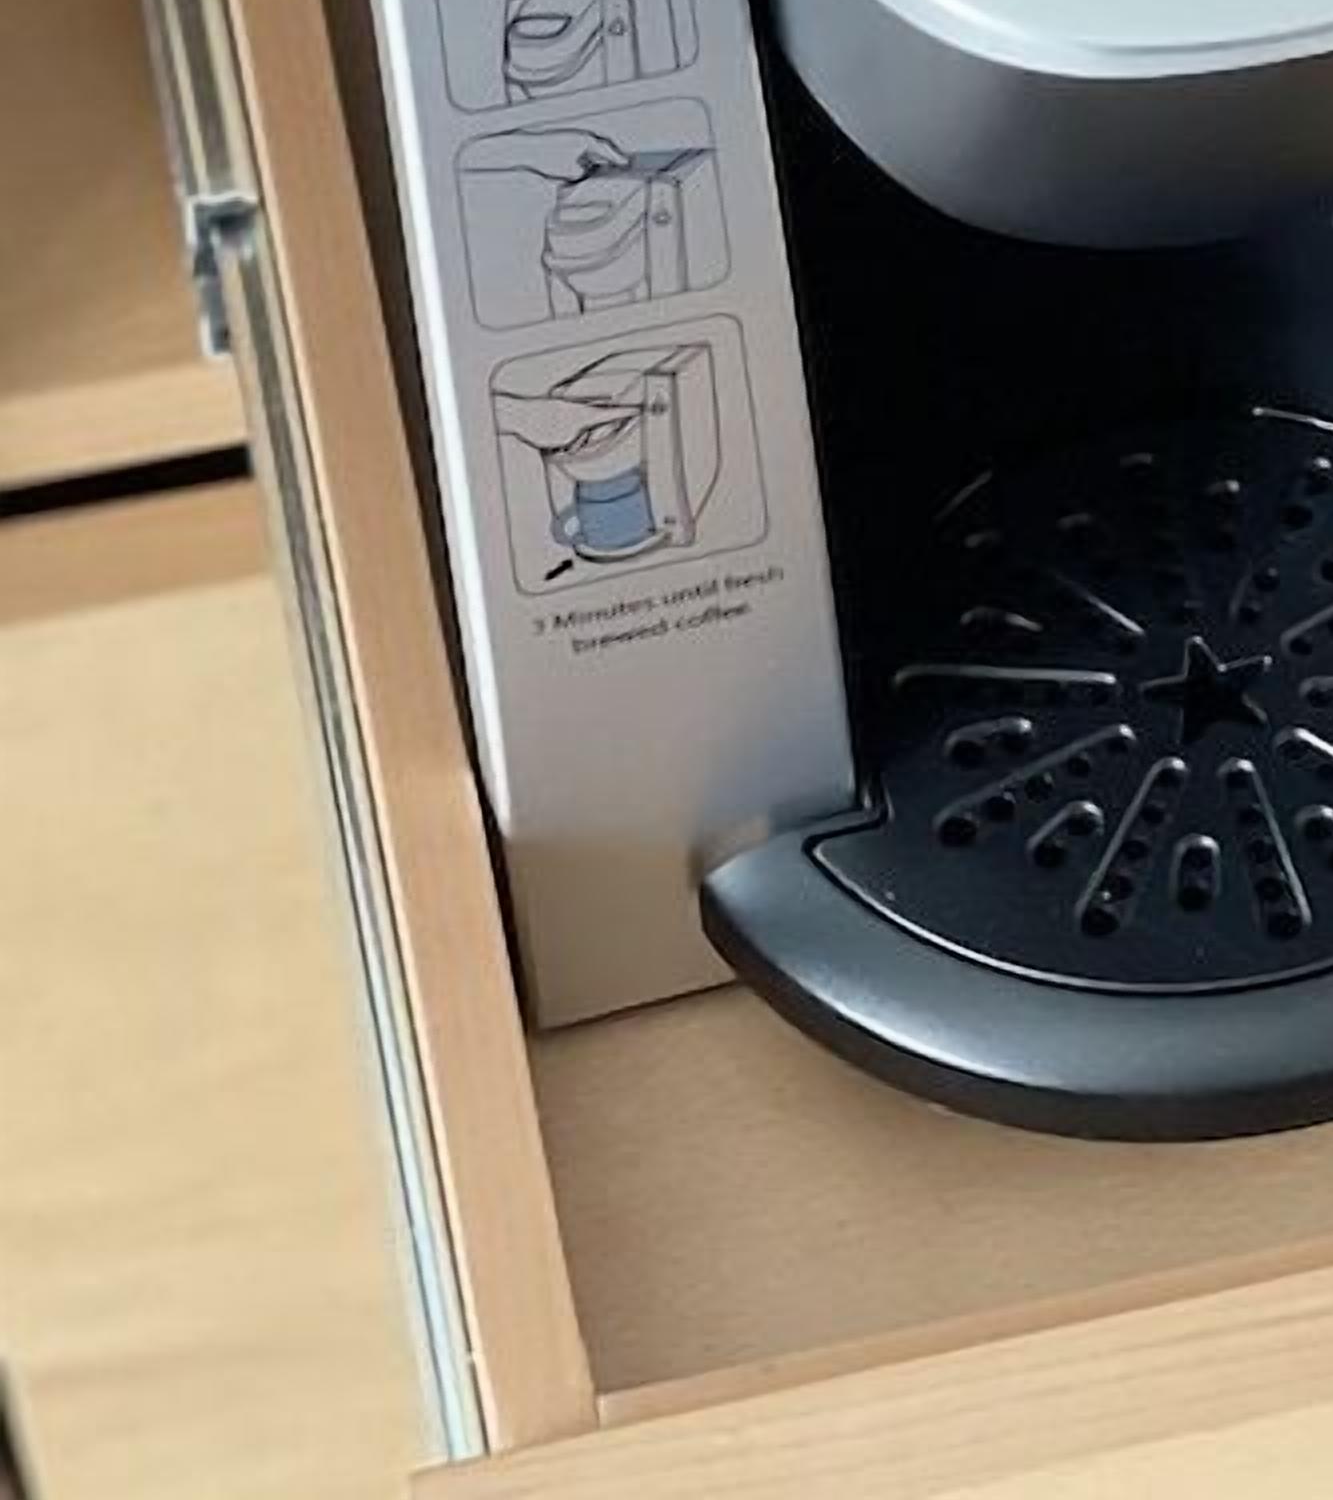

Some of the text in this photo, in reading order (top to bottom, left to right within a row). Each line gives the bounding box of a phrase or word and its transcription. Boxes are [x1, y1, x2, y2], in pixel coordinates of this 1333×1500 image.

[553, 598, 656, 630] Minutes
[661, 578, 719, 605] until
[724, 566, 784, 590] fresh
[571, 602, 751, 654] brewed coffee
